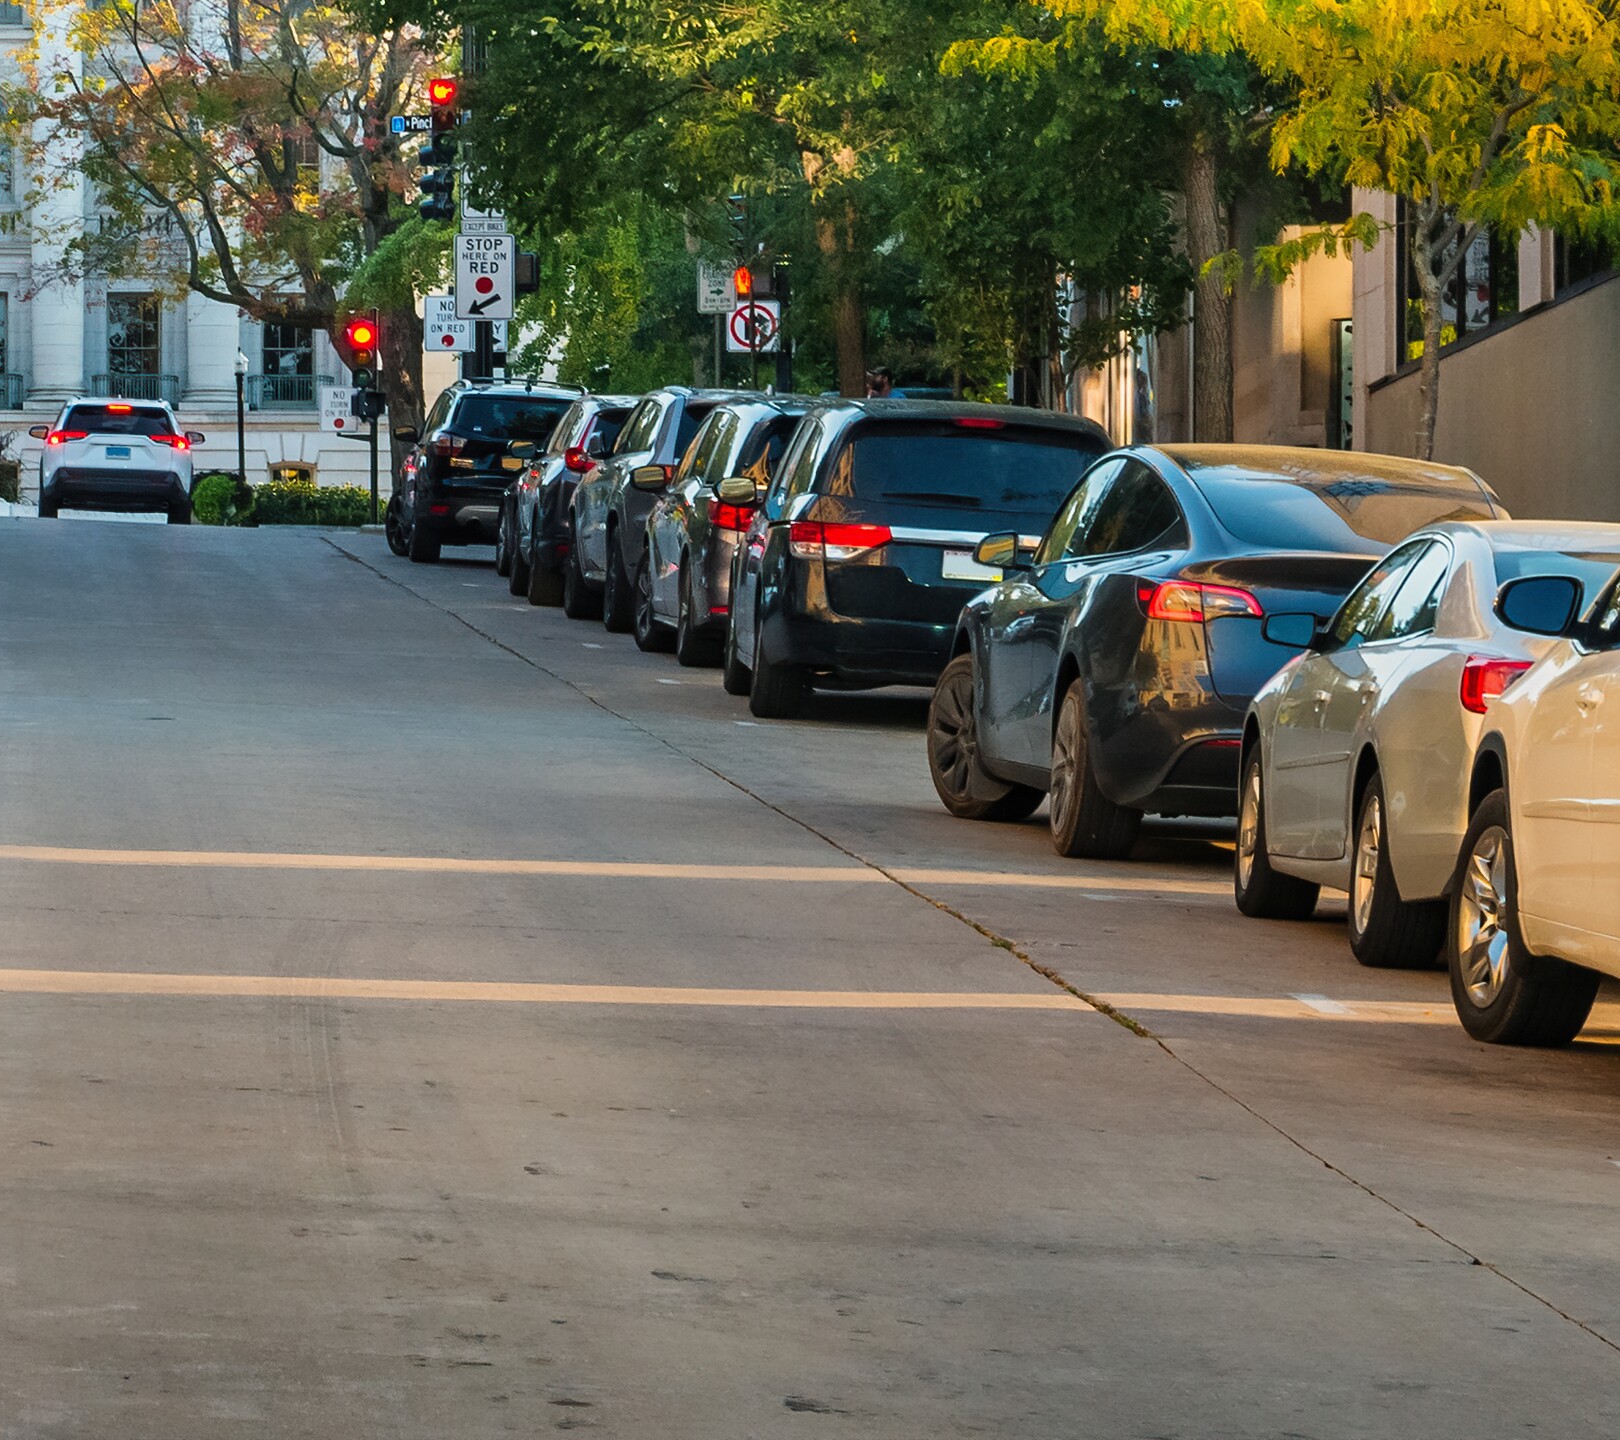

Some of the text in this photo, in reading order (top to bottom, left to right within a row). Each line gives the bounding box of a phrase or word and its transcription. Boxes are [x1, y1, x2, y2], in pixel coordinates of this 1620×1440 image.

[411, 116, 433, 129] Pinc
[466, 238, 503, 251] STOP
[462, 252, 507, 260] HERE ON
[469, 261, 499, 274] RED
[440, 301, 455, 312] NO
[436, 313, 456, 322] TUR
[430, 324, 465, 333] ON RED
[333, 390, 345, 399] NO
